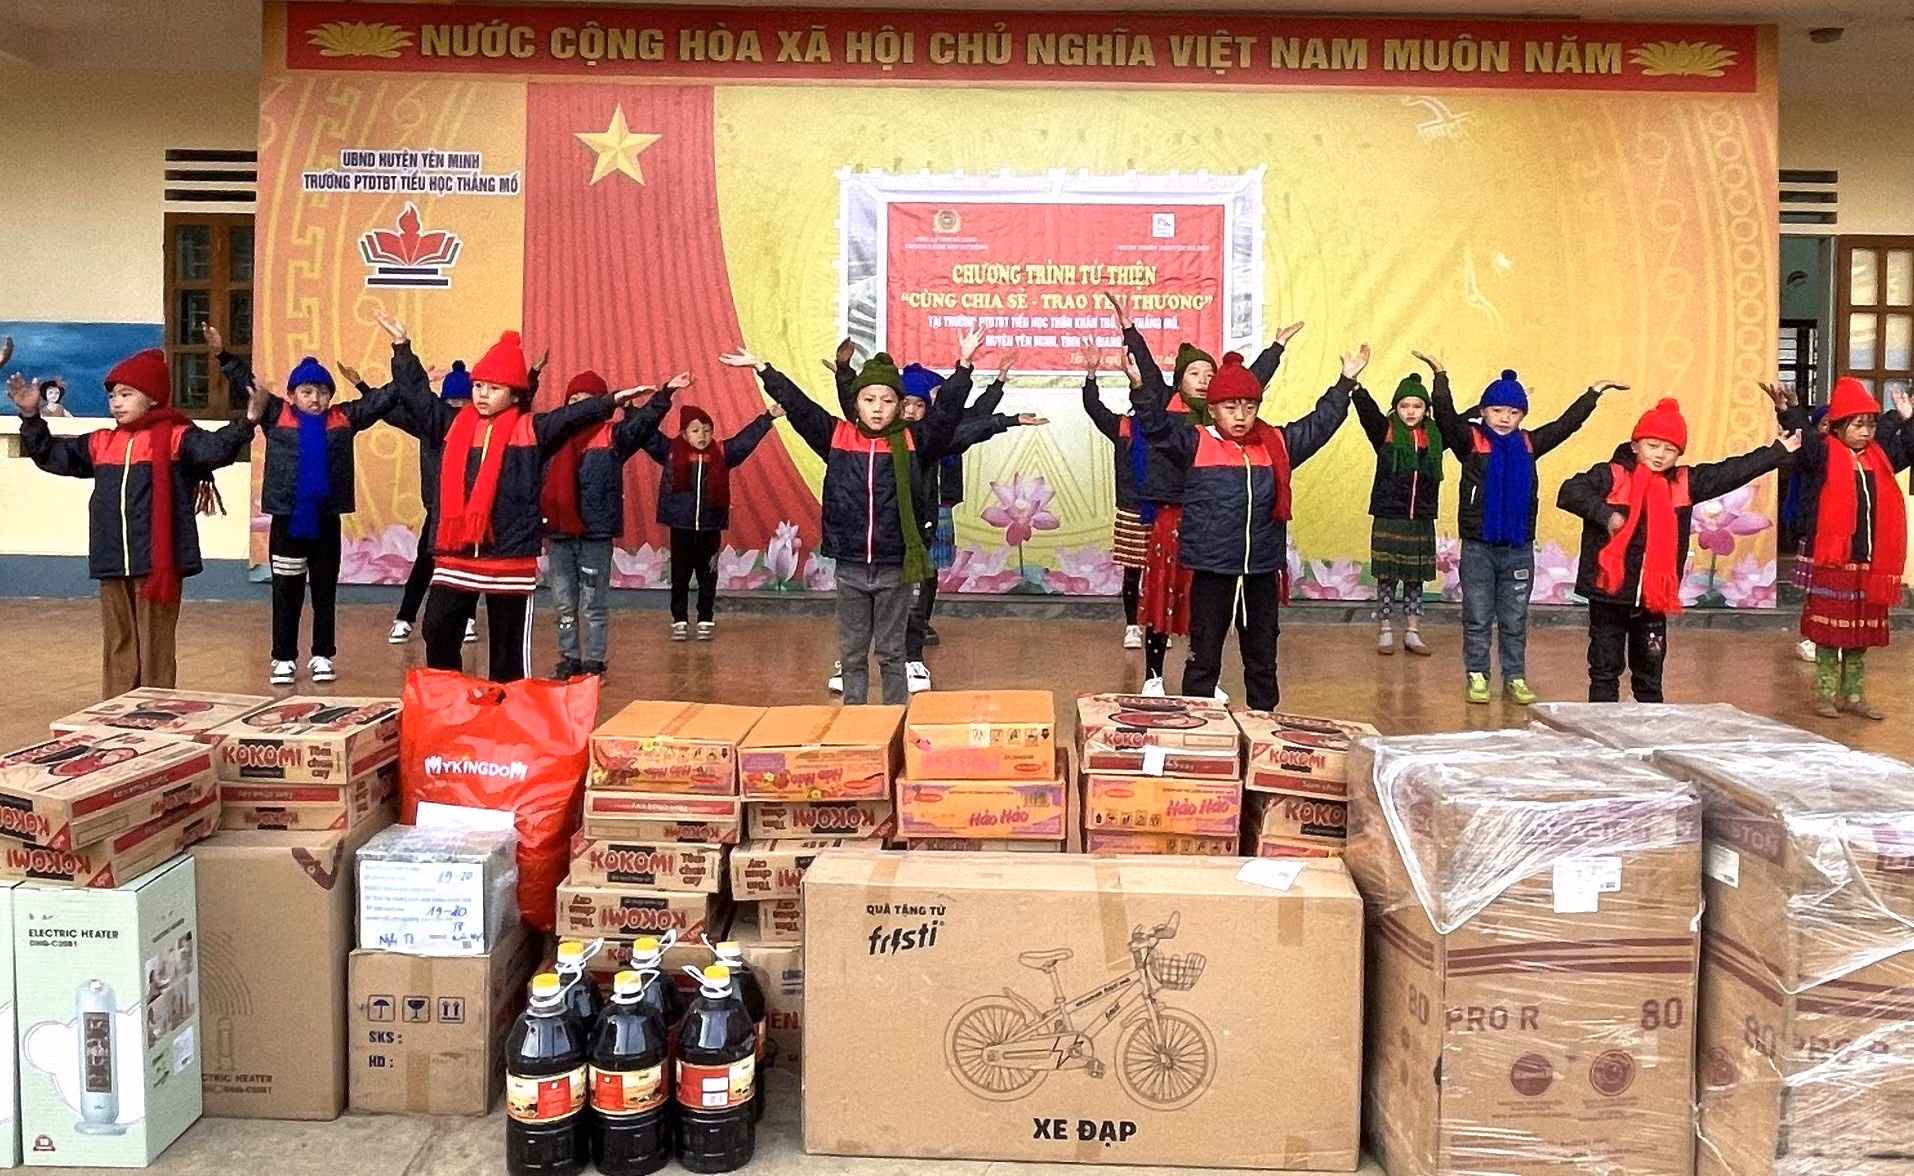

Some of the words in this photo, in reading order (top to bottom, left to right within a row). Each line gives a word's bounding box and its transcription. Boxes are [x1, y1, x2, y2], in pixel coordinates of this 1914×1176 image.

[421, 19, 535, 58] NƯỚC
[551, 21, 665, 66] CỘNG
[680, 22, 763, 62] HÒA
[777, 24, 831, 62] XÃ
[846, 25, 914, 71] HỘI
[930, 22, 1013, 64] CHỦ
[1026, 28, 1156, 67] NGHĨA
[1169, 30, 1258, 75] VIỆT
[1271, 37, 1368, 70] NAM
[1384, 33, 1510, 72] MUÔN
[1525, 34, 1622, 75] NĂM
[342, 152, 376, 167] UBND
[379, 149, 418, 172] HUYỆN
[421, 150, 444, 168] YÊN
[447, 153, 480, 169] MINH
[304, 169, 350, 190] TRƯỜNG
[354, 174, 397, 190] PTDTBT
[400, 168, 426, 191] TIỂU
[429, 176, 453, 195] HỌC
[952, 261, 1022, 285] CHƯƠNG
[1026, 258, 1076, 285] TRÌNH
[1107, 259, 1157, 291] THIỆN
[961, 293, 1004, 309] CHIA
[1041, 294, 1088, 310] TRAO
[222, 745, 301, 767] KOKOMI
[424, 755, 528, 781] MYKINGDOM
[1269, 750, 1326, 768] KOKOMI
[792, 806, 876, 828] KOKOMI
[969, 809, 998, 827] Hảo
[1000, 805, 1029, 825] Hảo
[1284, 801, 1347, 826] KOKO
[7, 848, 92, 875] KOKOMI
[590, 850, 675, 873] KOKOMI
[601, 908, 687, 929] KOKOMI
[866, 902, 891, 916] QUÀ
[894, 903, 927, 917] TẶNG
[929, 904, 946, 916] TỪ
[29, 929, 77, 938] ELECTRIC
[81, 929, 119, 939] HEATER
[868, 920, 939, 955] fristi
[1445, 1006, 1508, 1031] PRO
[1521, 1006, 1539, 1031] R
[1640, 997, 1683, 1031] 80
[1033, 1118, 1068, 1140] XE
[1076, 1119, 1137, 1148] ĐẠP
